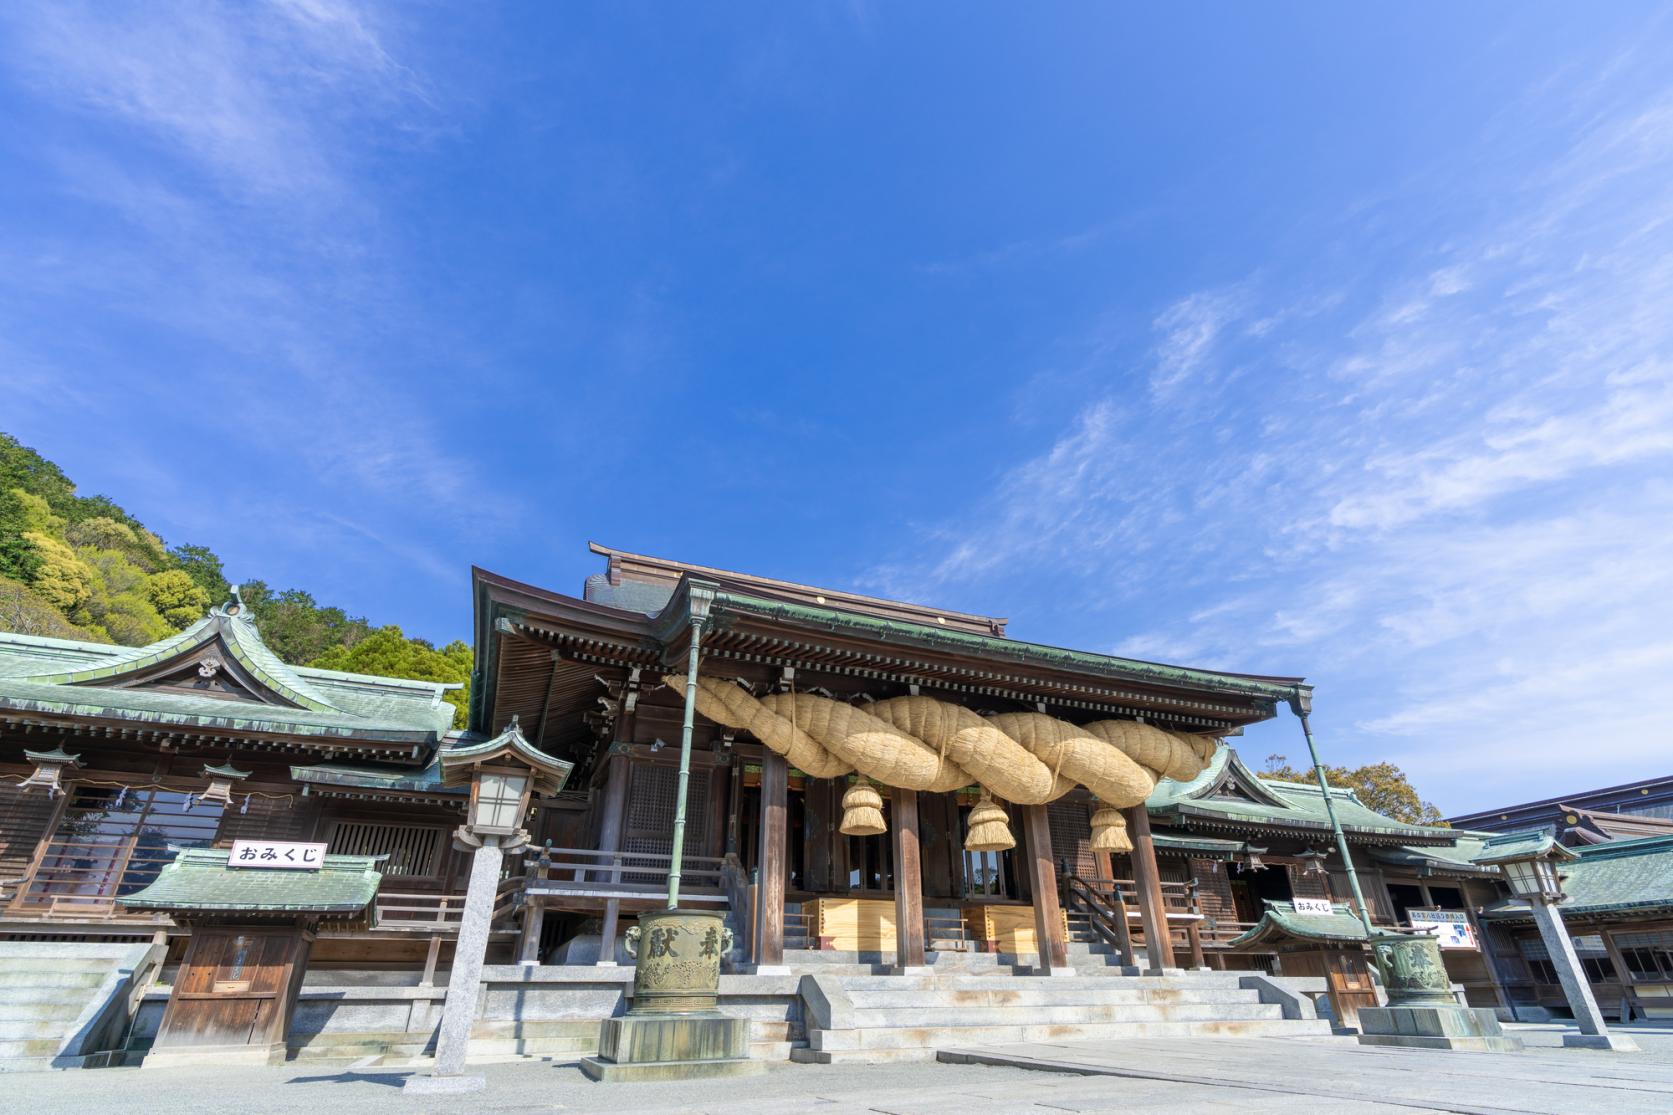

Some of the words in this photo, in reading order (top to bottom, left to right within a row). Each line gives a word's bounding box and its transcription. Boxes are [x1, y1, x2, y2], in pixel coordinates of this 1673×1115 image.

[239, 847, 317, 862] おみくじ
[1298, 902, 1329, 912] おみくじ
